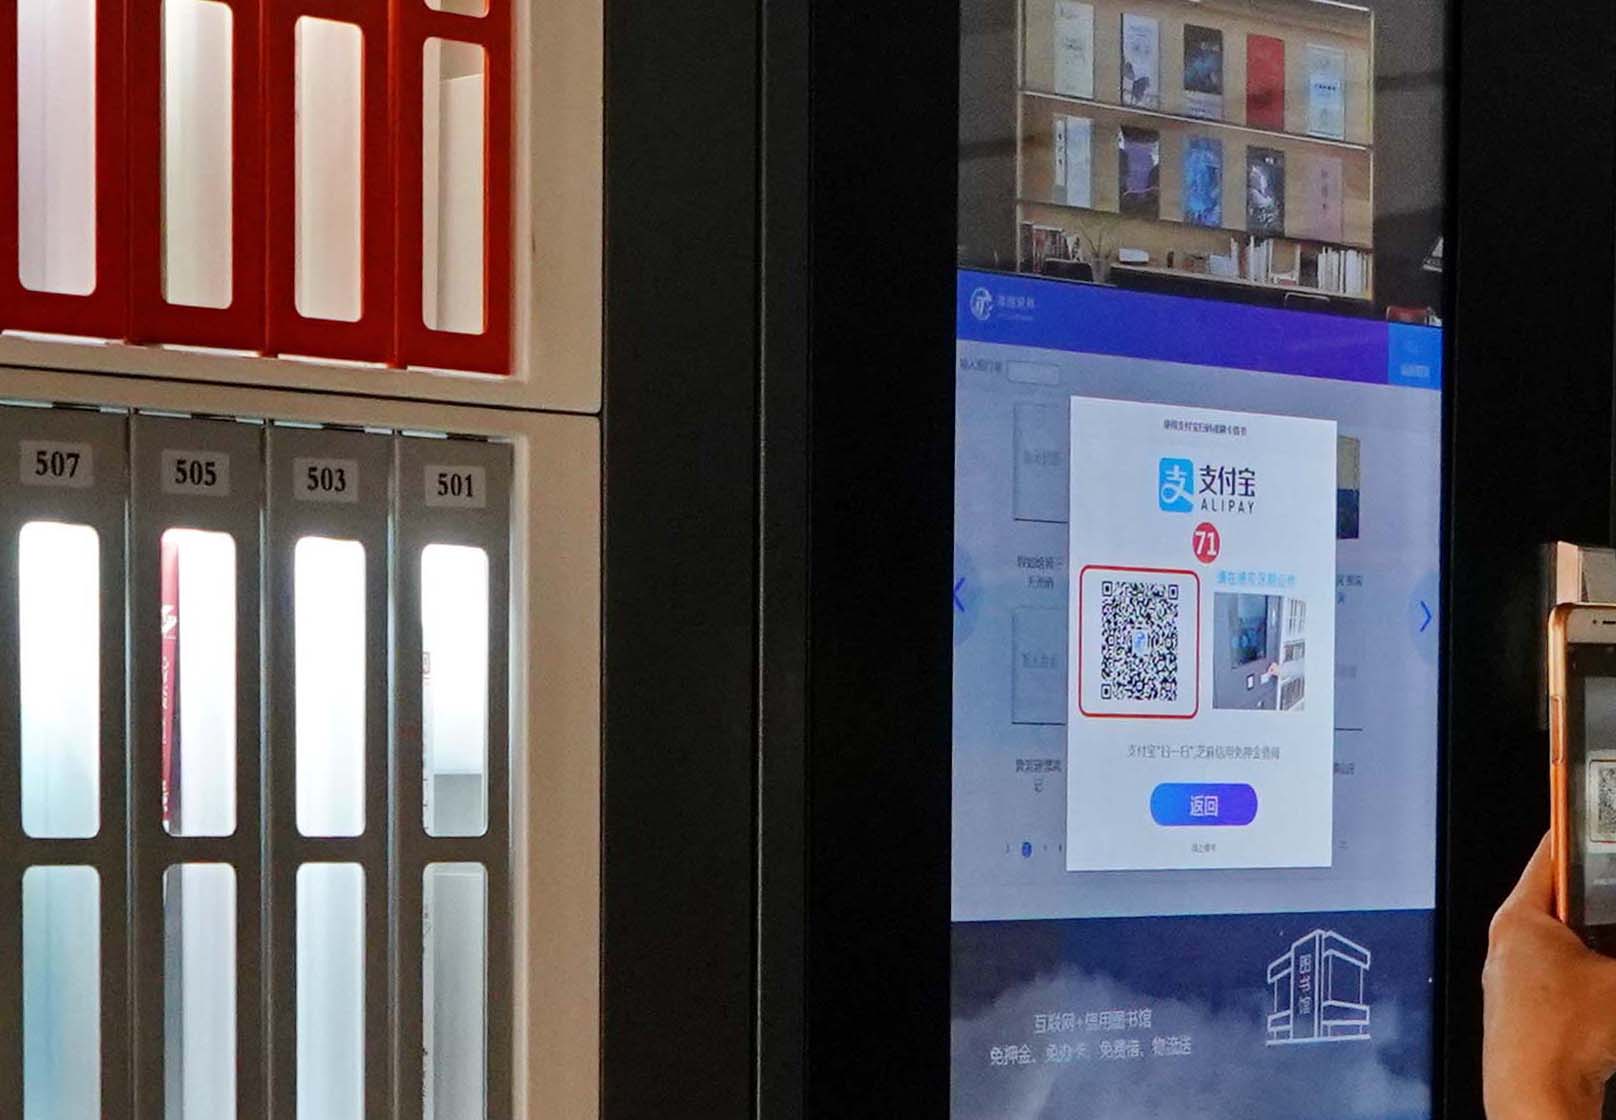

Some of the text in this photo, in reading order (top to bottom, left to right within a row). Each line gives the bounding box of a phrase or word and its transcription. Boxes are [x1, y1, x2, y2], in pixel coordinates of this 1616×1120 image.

[34, 450, 81, 478] 507
[174, 458, 218, 486] 505
[306, 466, 347, 493] 503
[436, 472, 474, 498] 501
[1199, 464, 1256, 498] 支付宝
[1200, 498, 1255, 515] ALIPAY
[1195, 531, 1217, 556] 71
[1190, 795, 1218, 817] 返回
